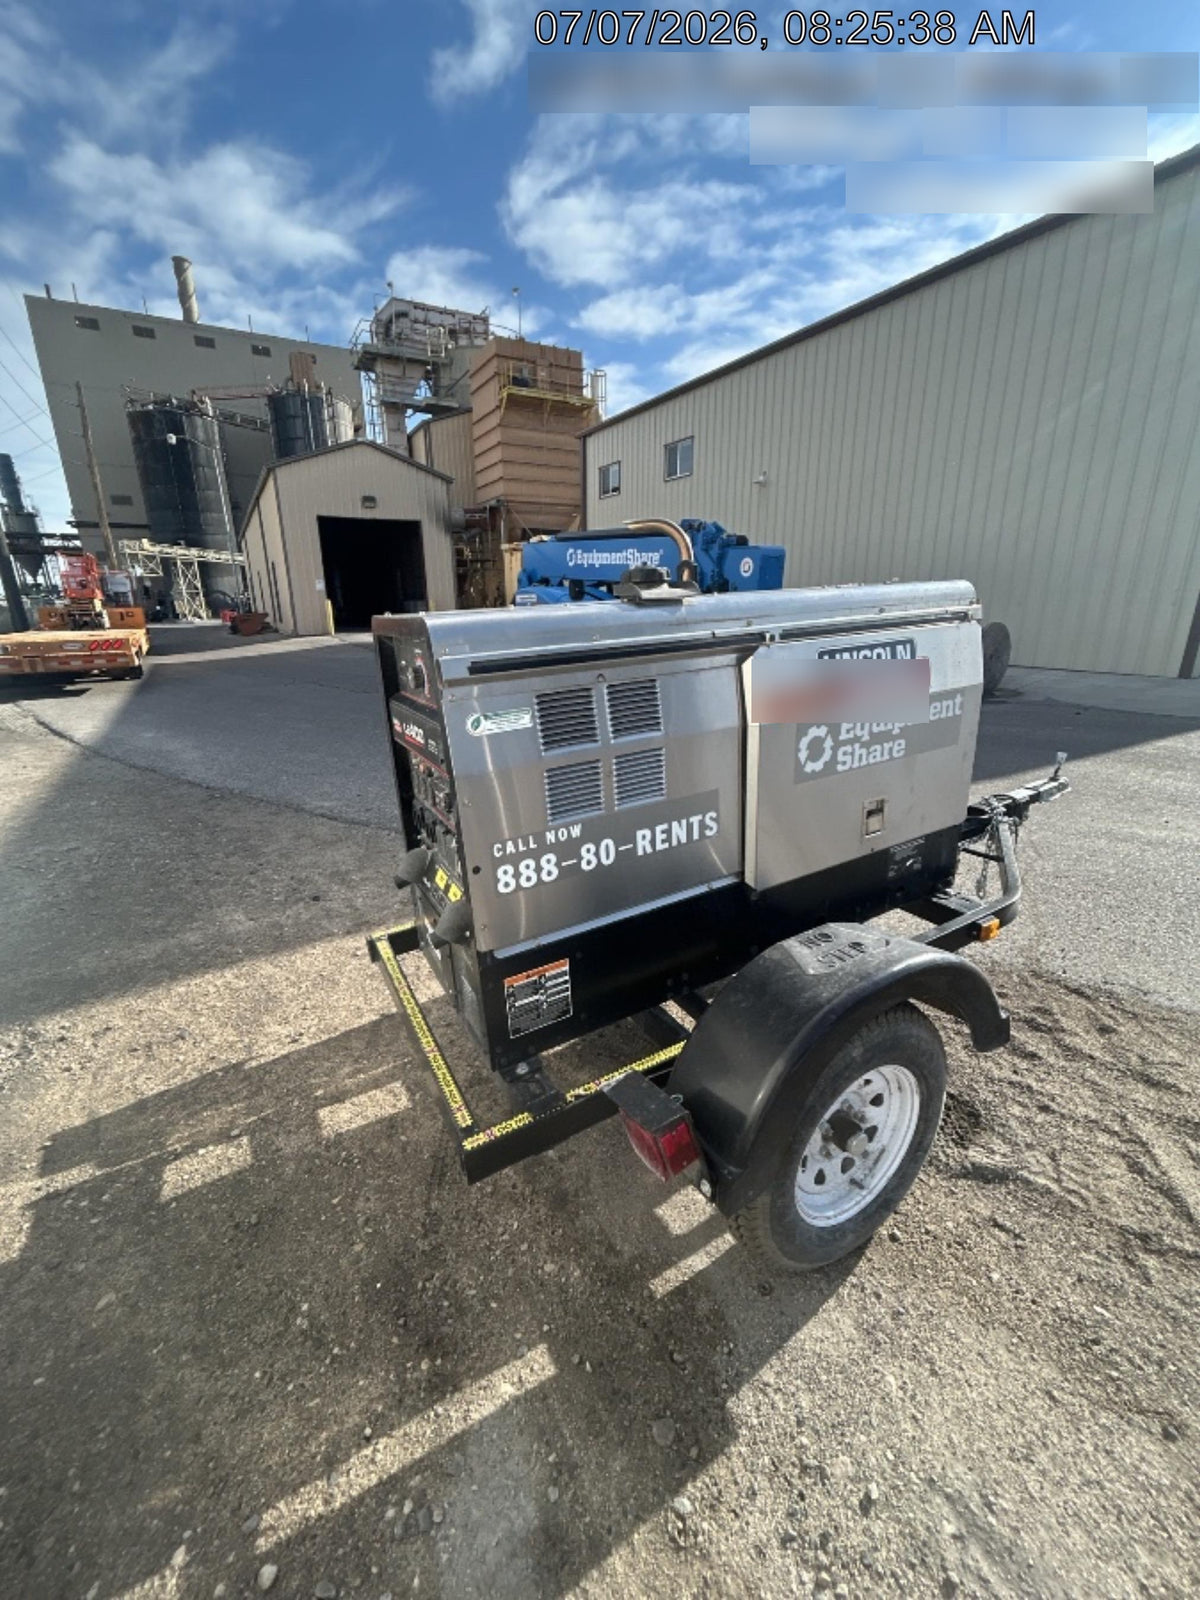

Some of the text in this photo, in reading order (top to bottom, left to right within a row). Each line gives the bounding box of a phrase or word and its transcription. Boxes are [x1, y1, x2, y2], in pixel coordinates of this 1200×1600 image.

[823, 643, 911, 659] COLN
[838, 693, 962, 742] Equent
[836, 738, 906, 772] Share
[493, 823, 583, 857] CALL NOW
[496, 811, 719, 894] 888-80-RENTS
